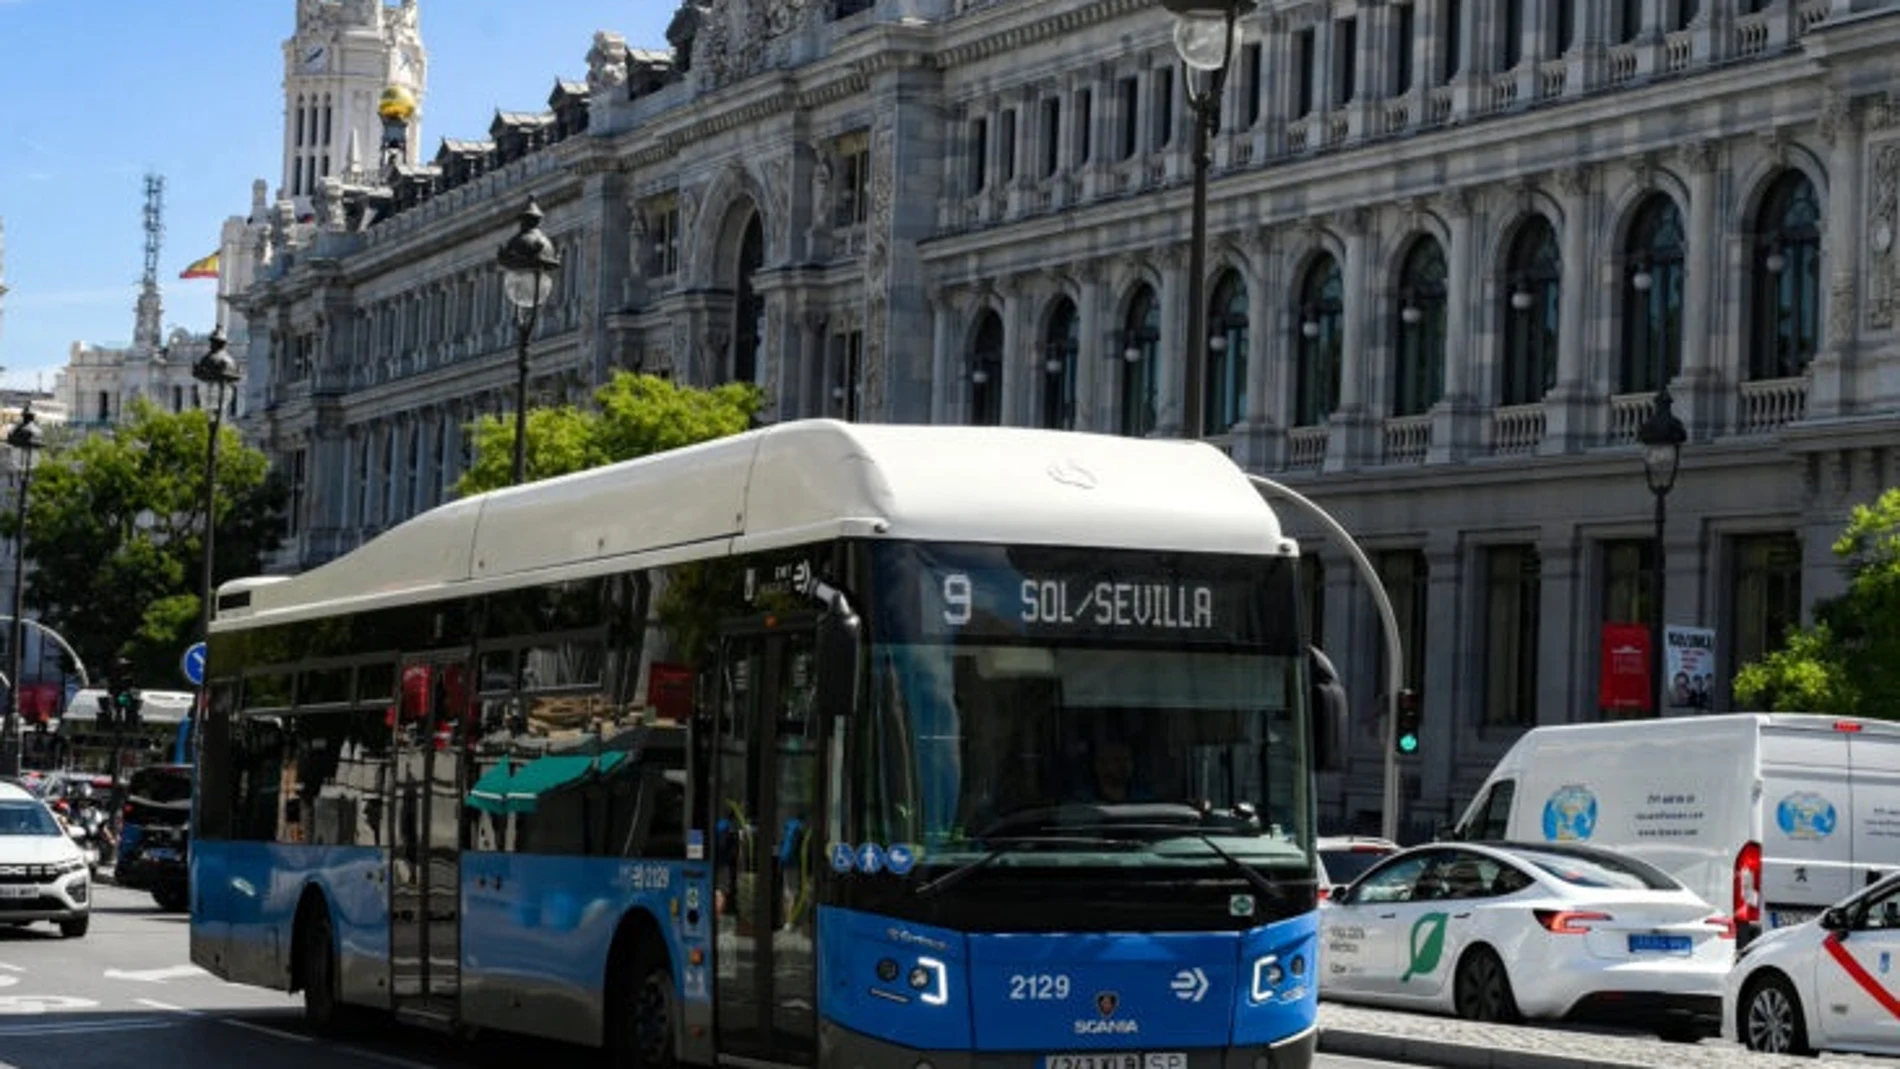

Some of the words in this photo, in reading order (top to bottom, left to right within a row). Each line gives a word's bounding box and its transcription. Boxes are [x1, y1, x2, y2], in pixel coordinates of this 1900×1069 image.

[943, 573, 972, 625] 9
[1021, 579, 1212, 628] SOL/SEVILLA
[1009, 974, 1071, 1000] 2129
[1074, 1019, 1138, 1034] SCANIA
